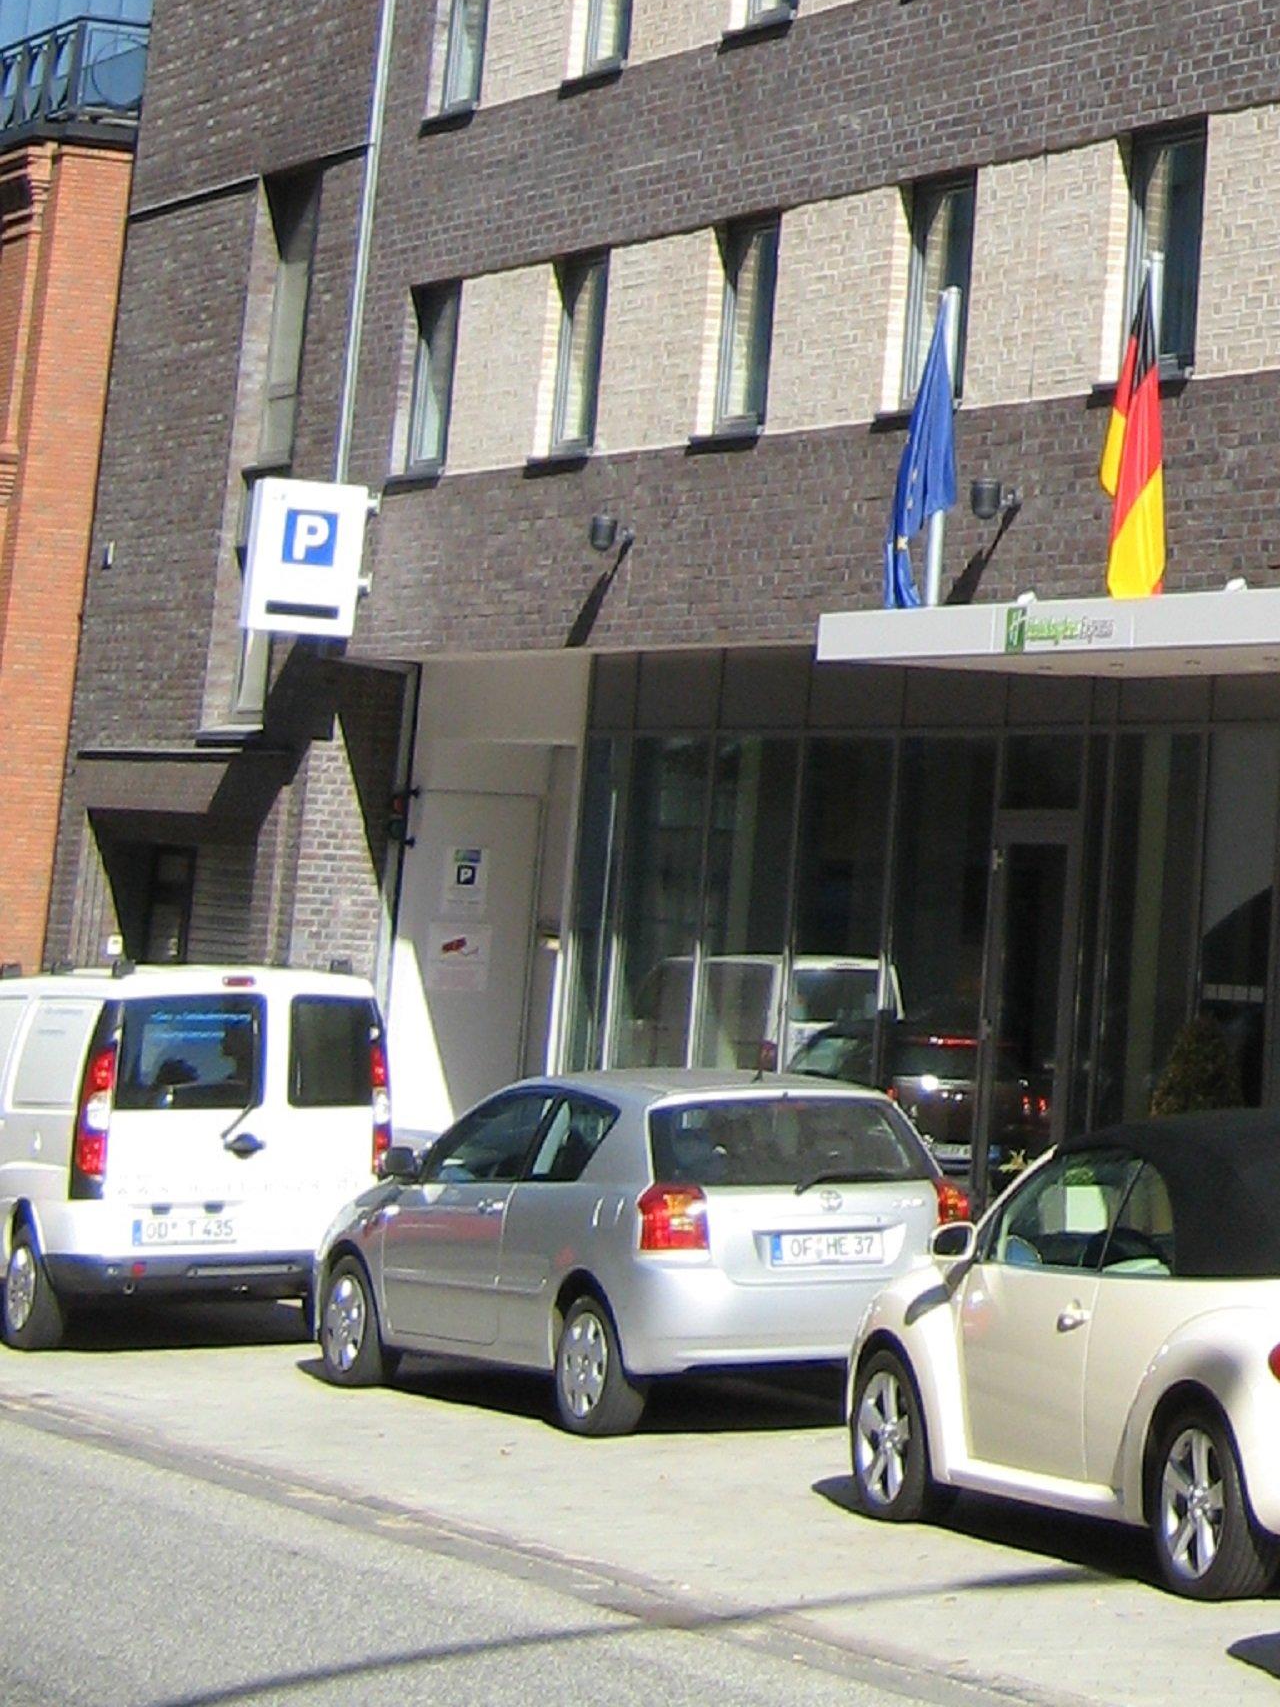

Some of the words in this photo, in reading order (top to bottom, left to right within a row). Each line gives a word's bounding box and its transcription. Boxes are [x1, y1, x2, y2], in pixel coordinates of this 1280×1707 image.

[291, 513, 330, 562] P
[202, 1219, 234, 1237] 435
[854, 1235, 874, 1256] 37
